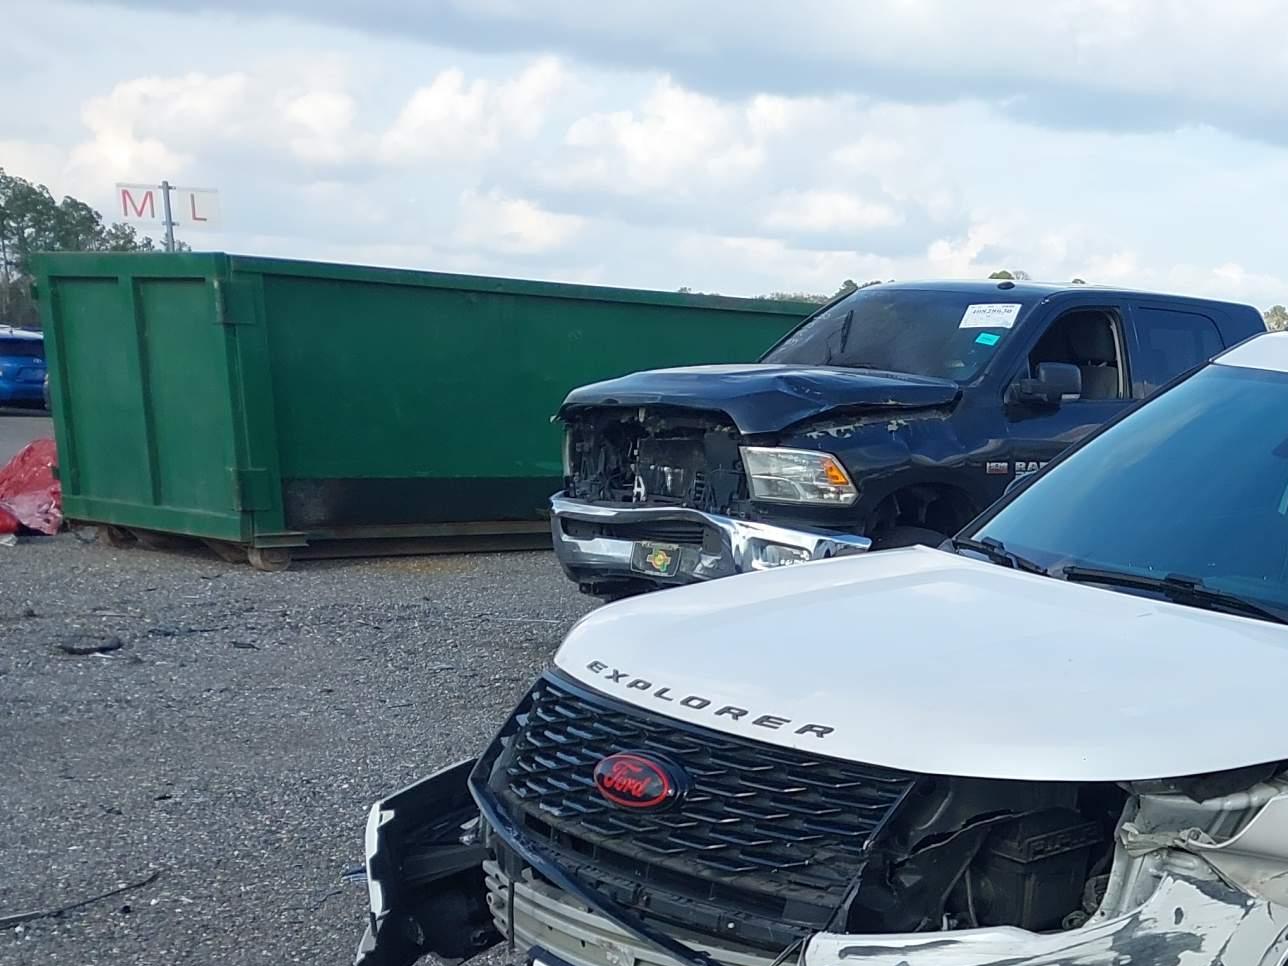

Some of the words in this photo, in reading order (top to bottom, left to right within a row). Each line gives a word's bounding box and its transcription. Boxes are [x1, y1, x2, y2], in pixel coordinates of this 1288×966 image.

[121, 189, 155, 218] M
[190, 193, 207, 221] L
[586, 660, 835, 739] EXPLORER
[603, 760, 653, 798] Ford
